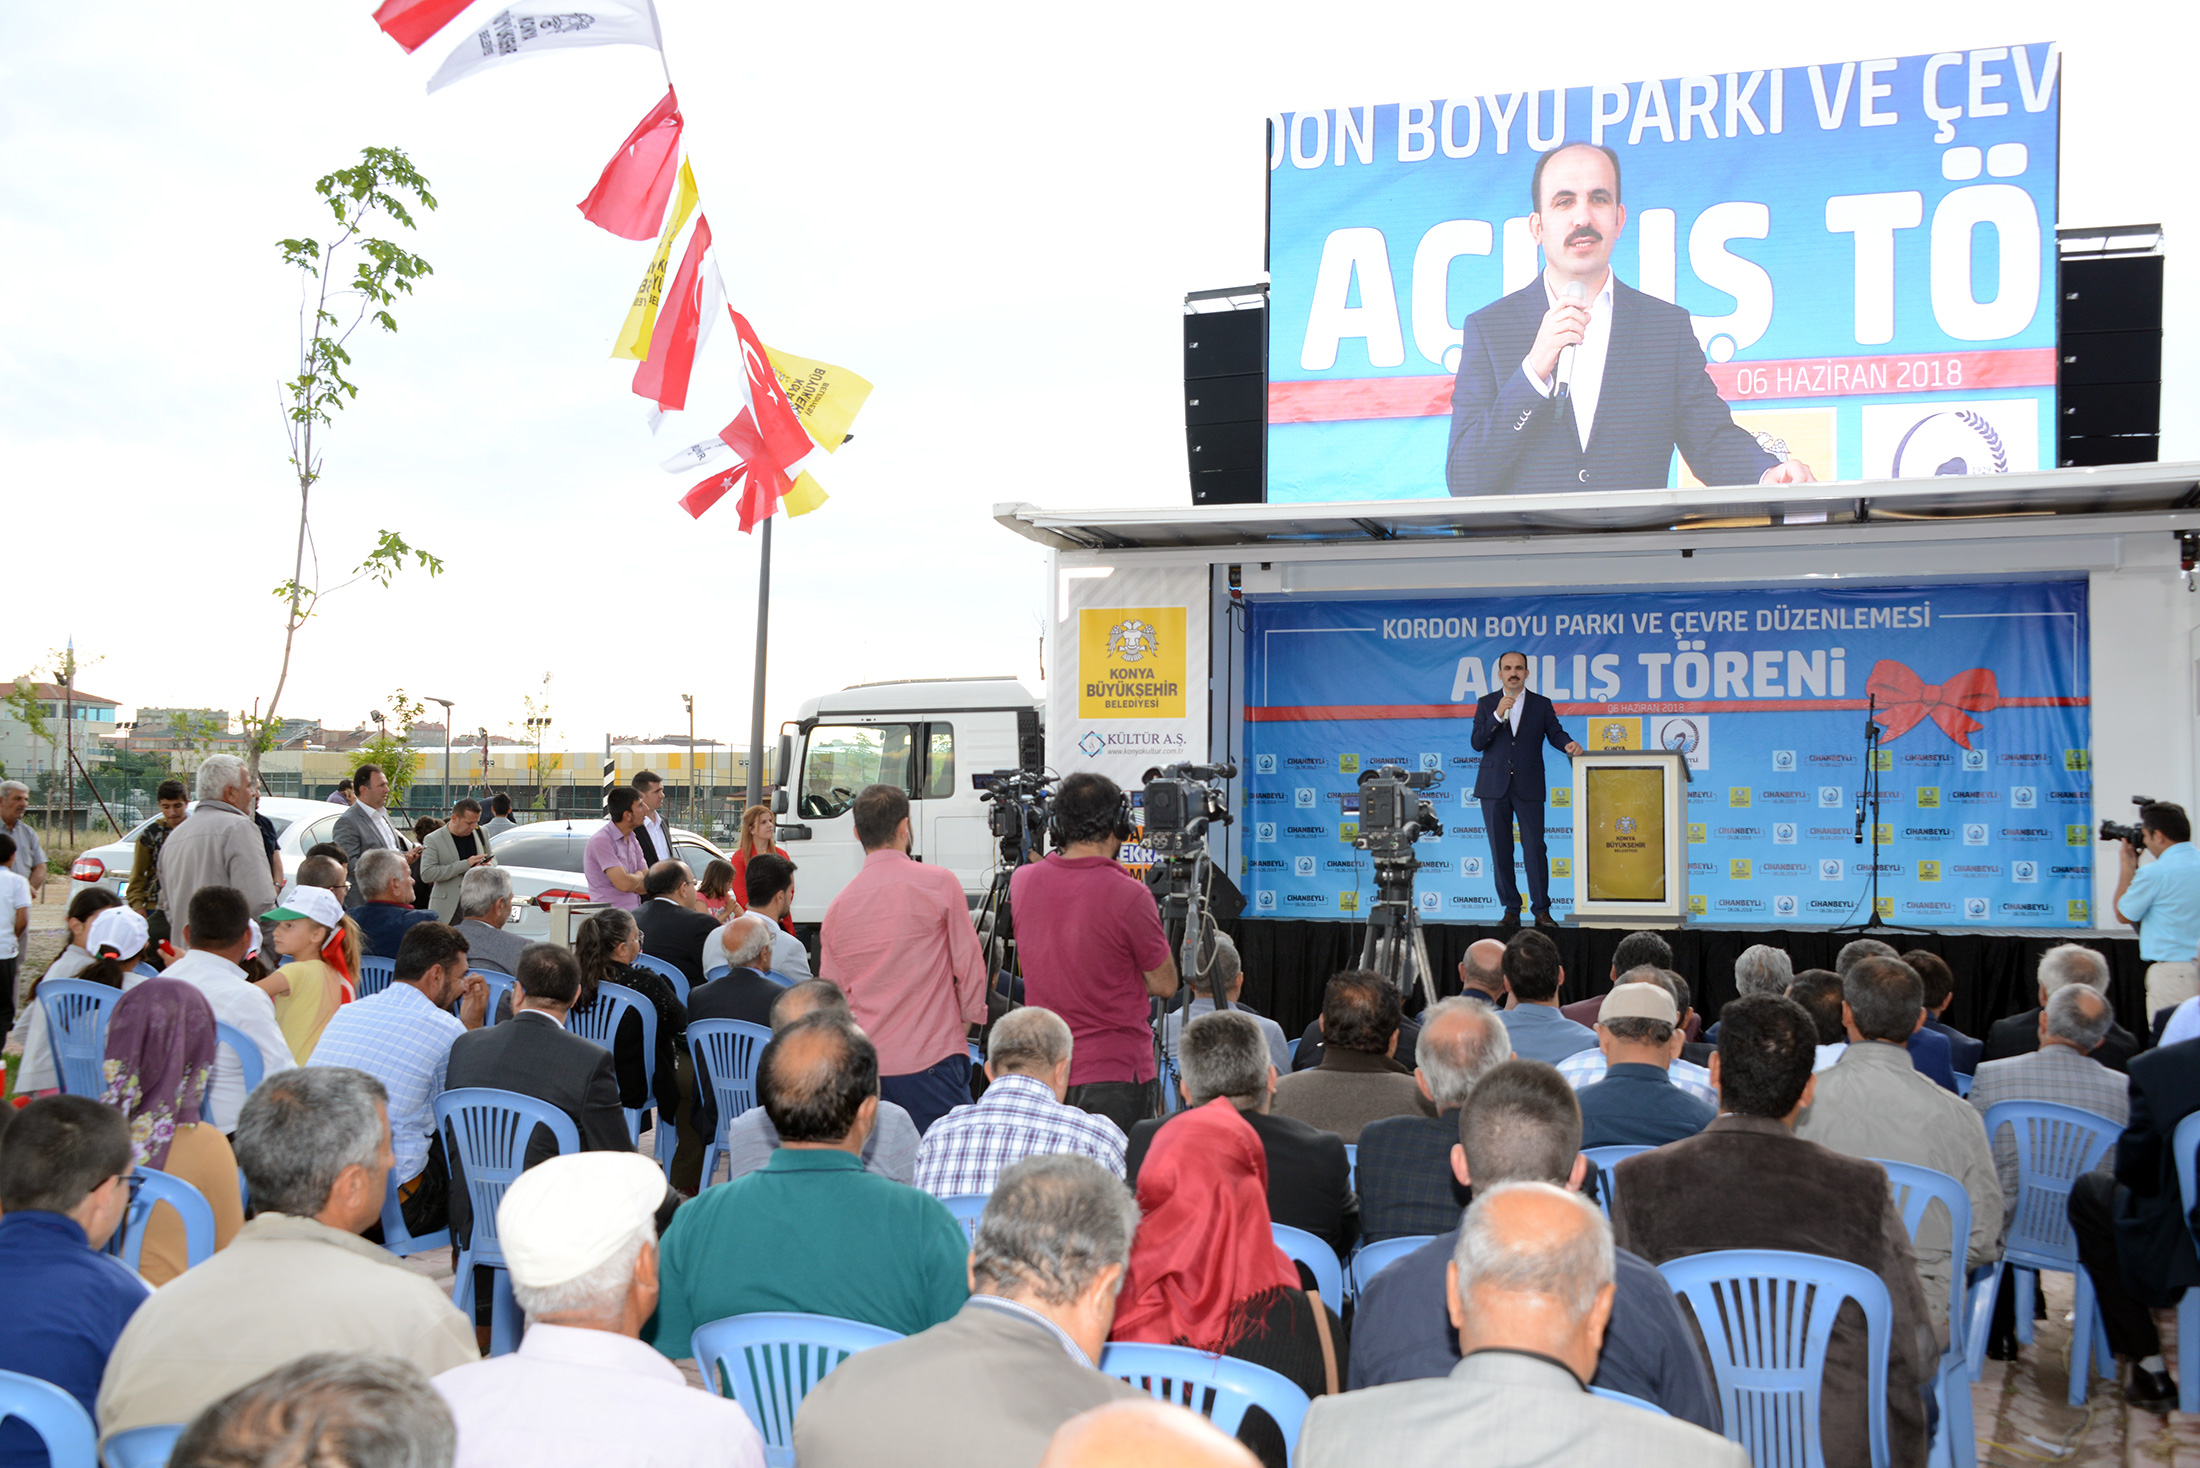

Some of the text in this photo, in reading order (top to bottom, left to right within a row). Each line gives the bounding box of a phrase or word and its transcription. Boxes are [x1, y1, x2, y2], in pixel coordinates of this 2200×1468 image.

[1398, 88, 1566, 163] BOYU
[1591, 68, 1785, 146] PARKI
[1807, 58, 1899, 130] VE
[1922, 42, 2059, 144] ÇEV
[1824, 142, 2042, 346] TÖ
[1737, 359, 1962, 395] 06 HAZİRAN 2018
[1383, 600, 1931, 640] KORDON BOYU PARKI VE ÇEVRE DÜZENLEMESİ
[1110, 668, 1155, 680] KONYA
[1450, 653, 1621, 703] AILIŞ
[1086, 680, 1178, 699] BÜYÜKŞEHİR
[1105, 697, 1159, 709] BELEDİYESİ
[1608, 702, 1685, 713] 06 HAZİRAN 2018
[1107, 731, 1187, 747] KÜLTÜR A.Ş.
[1107, 747, 1184, 756] www.konyakultur.com.tr
